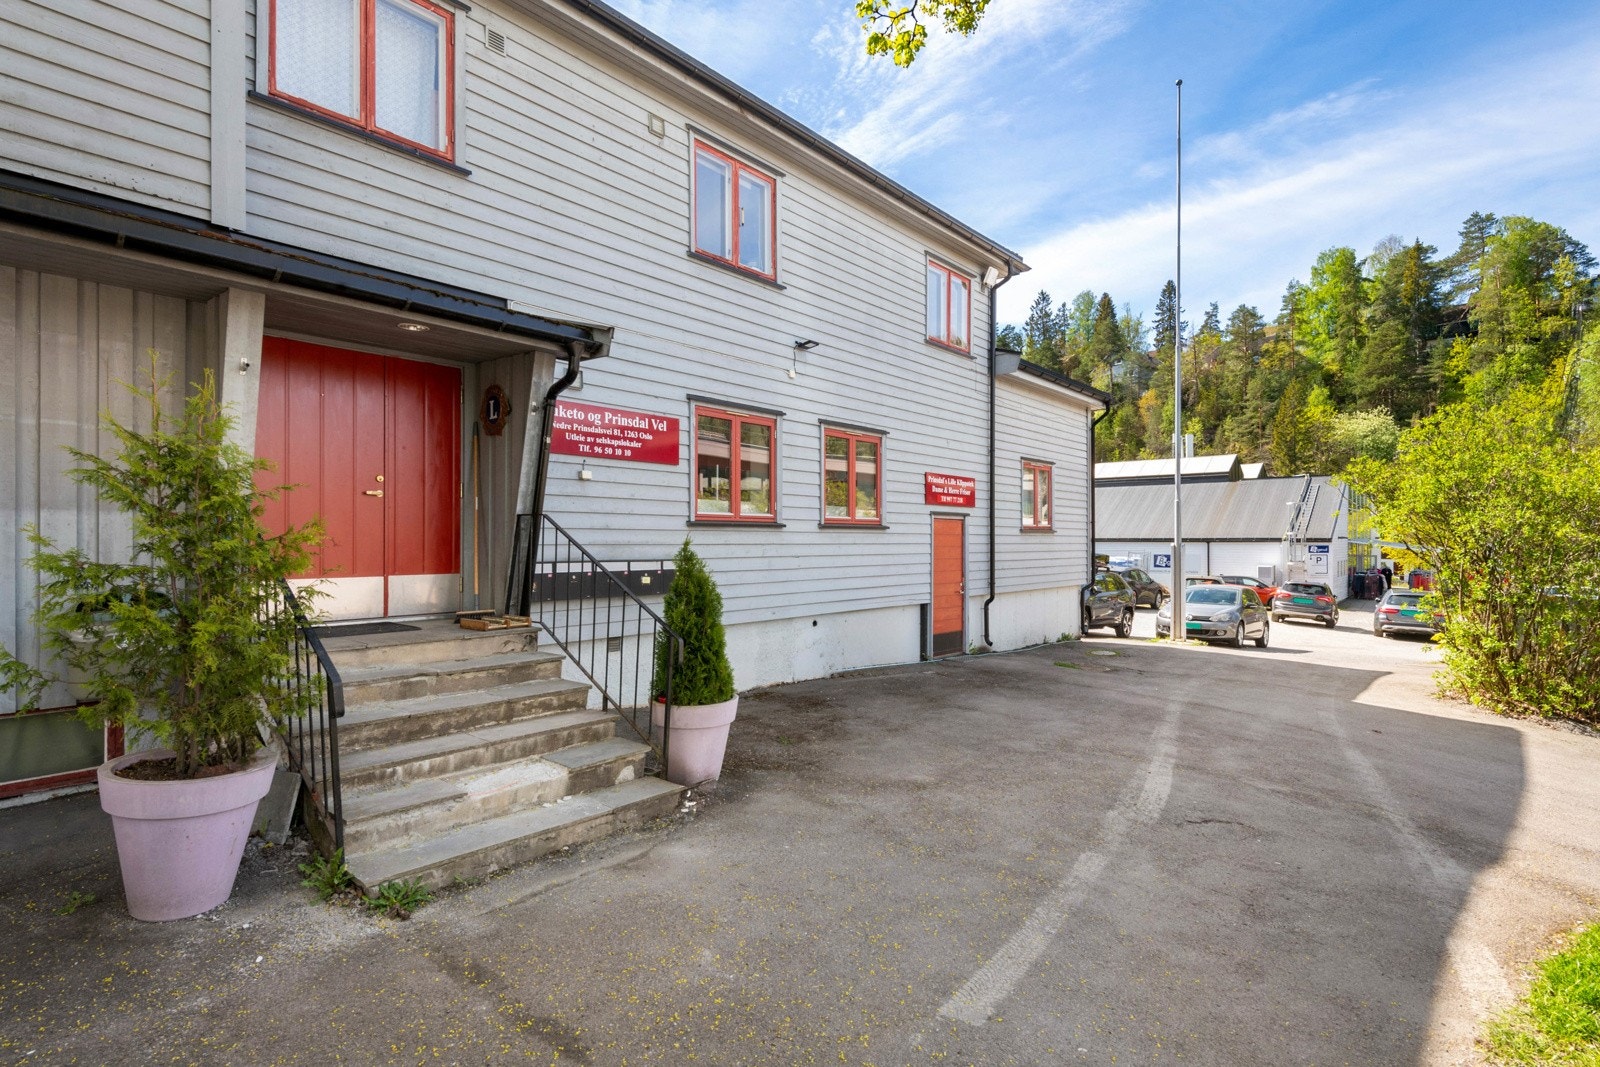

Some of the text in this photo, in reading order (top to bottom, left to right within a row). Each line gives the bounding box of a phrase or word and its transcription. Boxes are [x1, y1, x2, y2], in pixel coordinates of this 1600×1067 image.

[588, 412, 601, 425] og
[604, 411, 648, 429] Prinsdal
[651, 419, 667, 431] Vel
[573, 422, 612, 436] Prinsdalsvei
[613, 429, 623, 437] 81,
[624, 430, 638, 439] 1263
[639, 432, 653, 440] Oslo
[565, 432, 585, 442] Utleie
[596, 436, 642, 448] selskapslokaler
[578, 444, 631, 456] Tlf. 96 50 10 10
